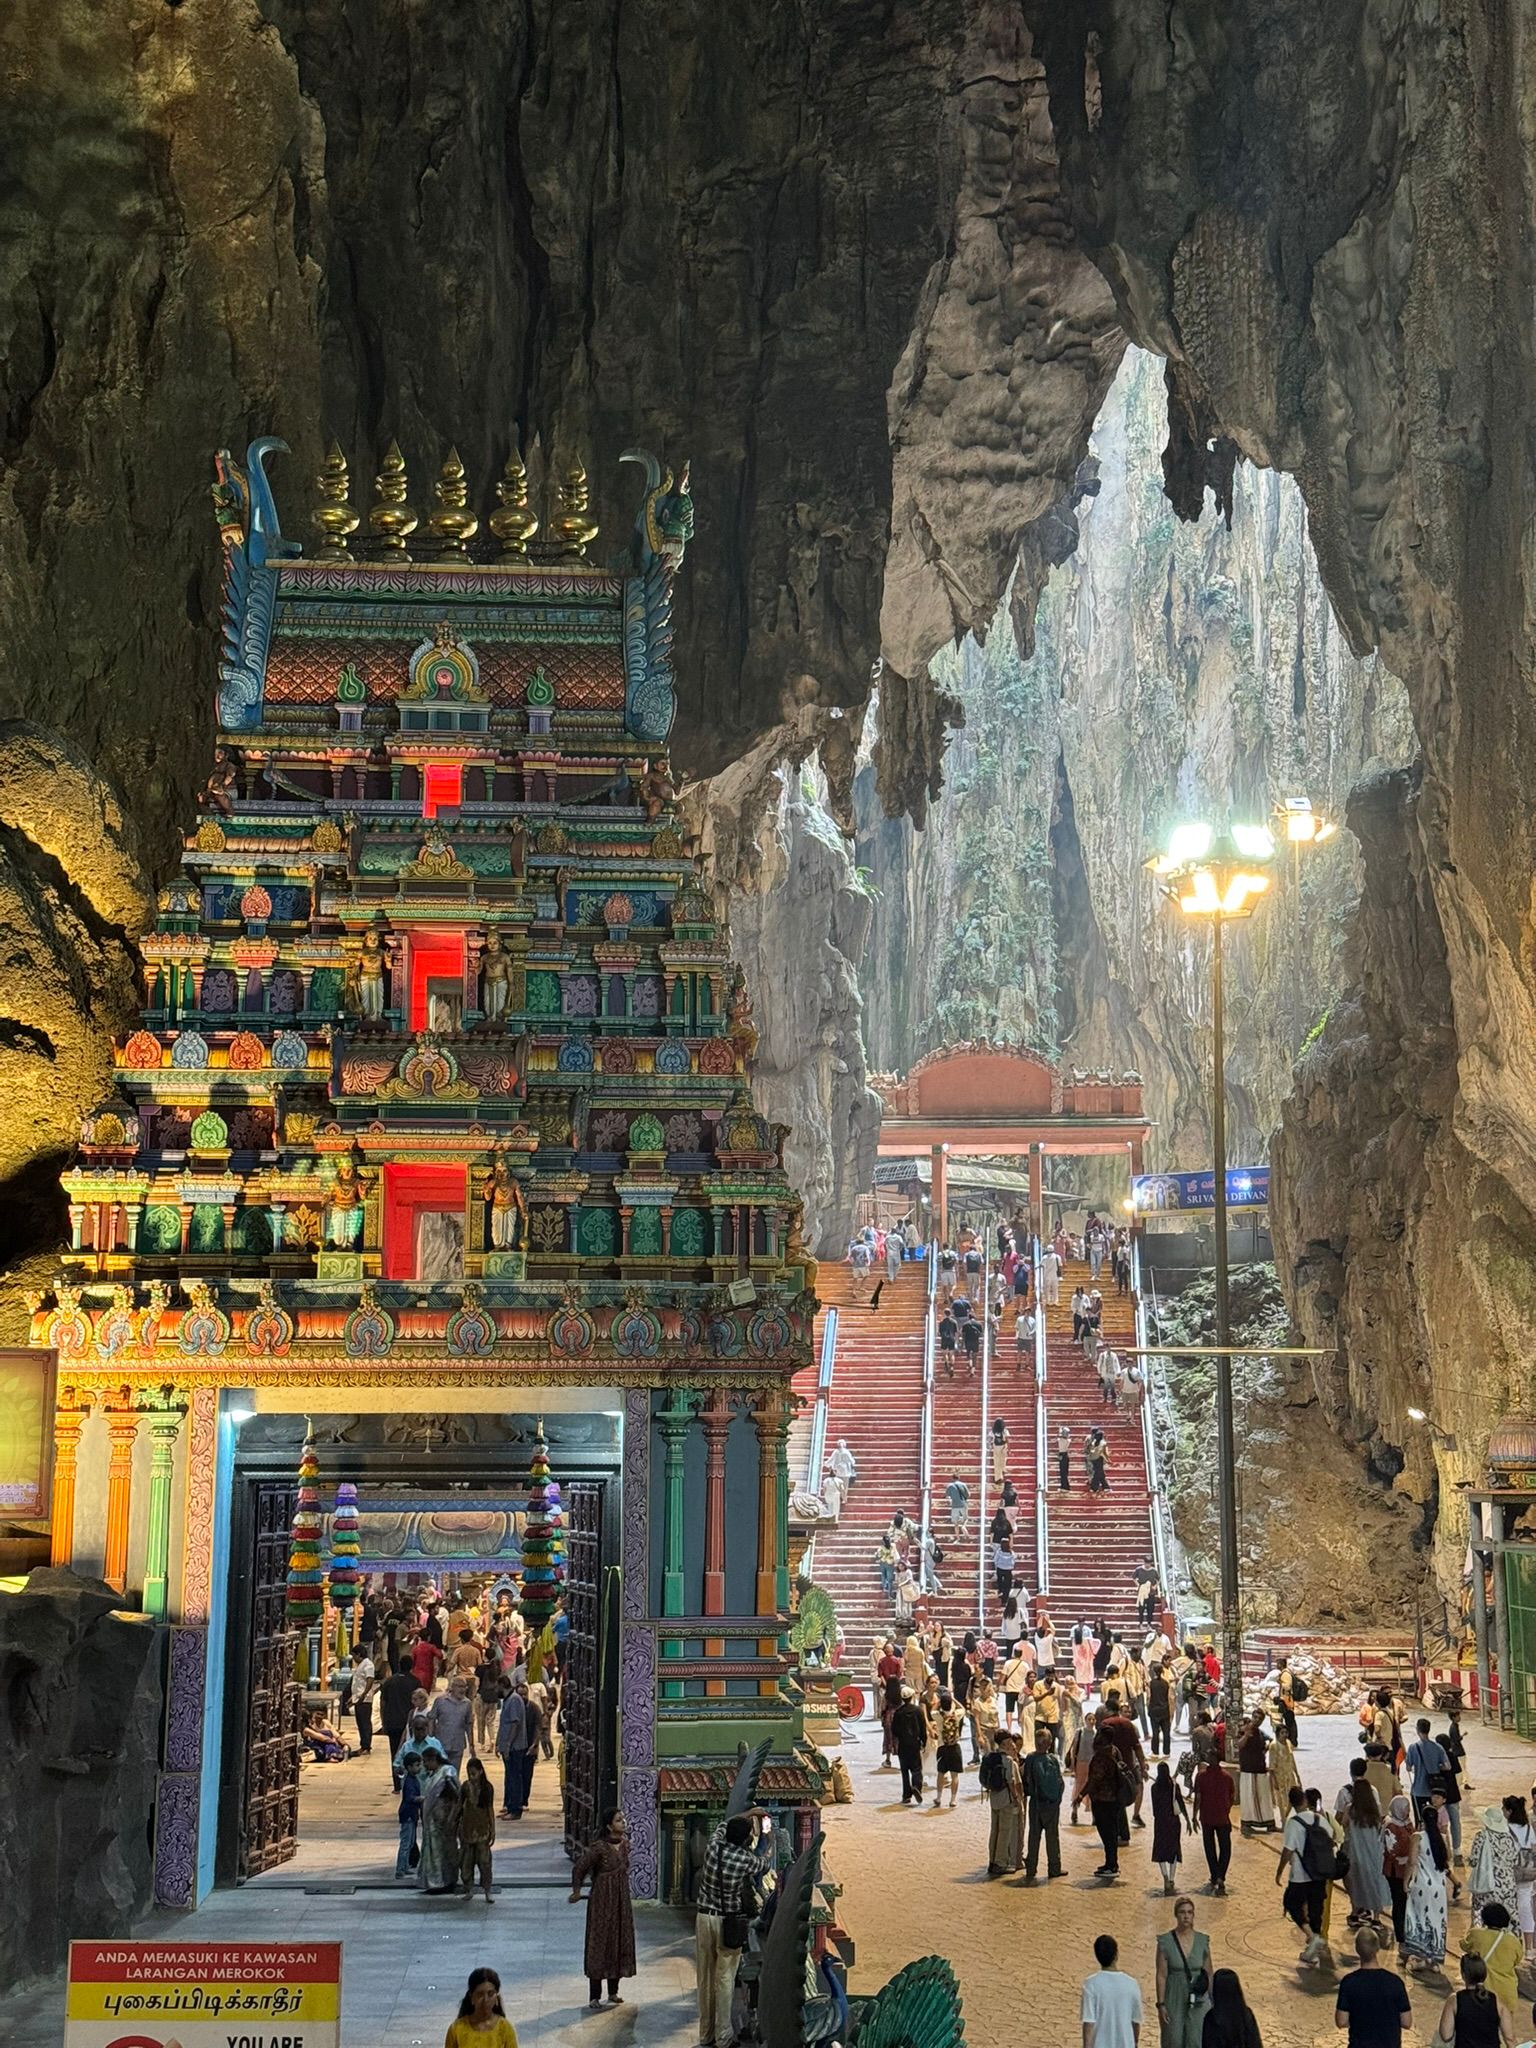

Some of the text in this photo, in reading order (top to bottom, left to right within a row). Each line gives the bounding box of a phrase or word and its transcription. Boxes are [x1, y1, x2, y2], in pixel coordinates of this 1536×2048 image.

[1186, 1190, 1268, 1204] SRI VAI DEIVAN
[811, 1703, 838, 1714] SHOES
[95, 1952, 318, 1964] ANDA MEMASUKI KE KAWASAN
[126, 1967, 285, 1979] LARANGAN MEROKOK
[104, 1987, 303, 2017] புகைப்பிடிக்காதீர்
[227, 2036, 303, 2048] YOU ARE
